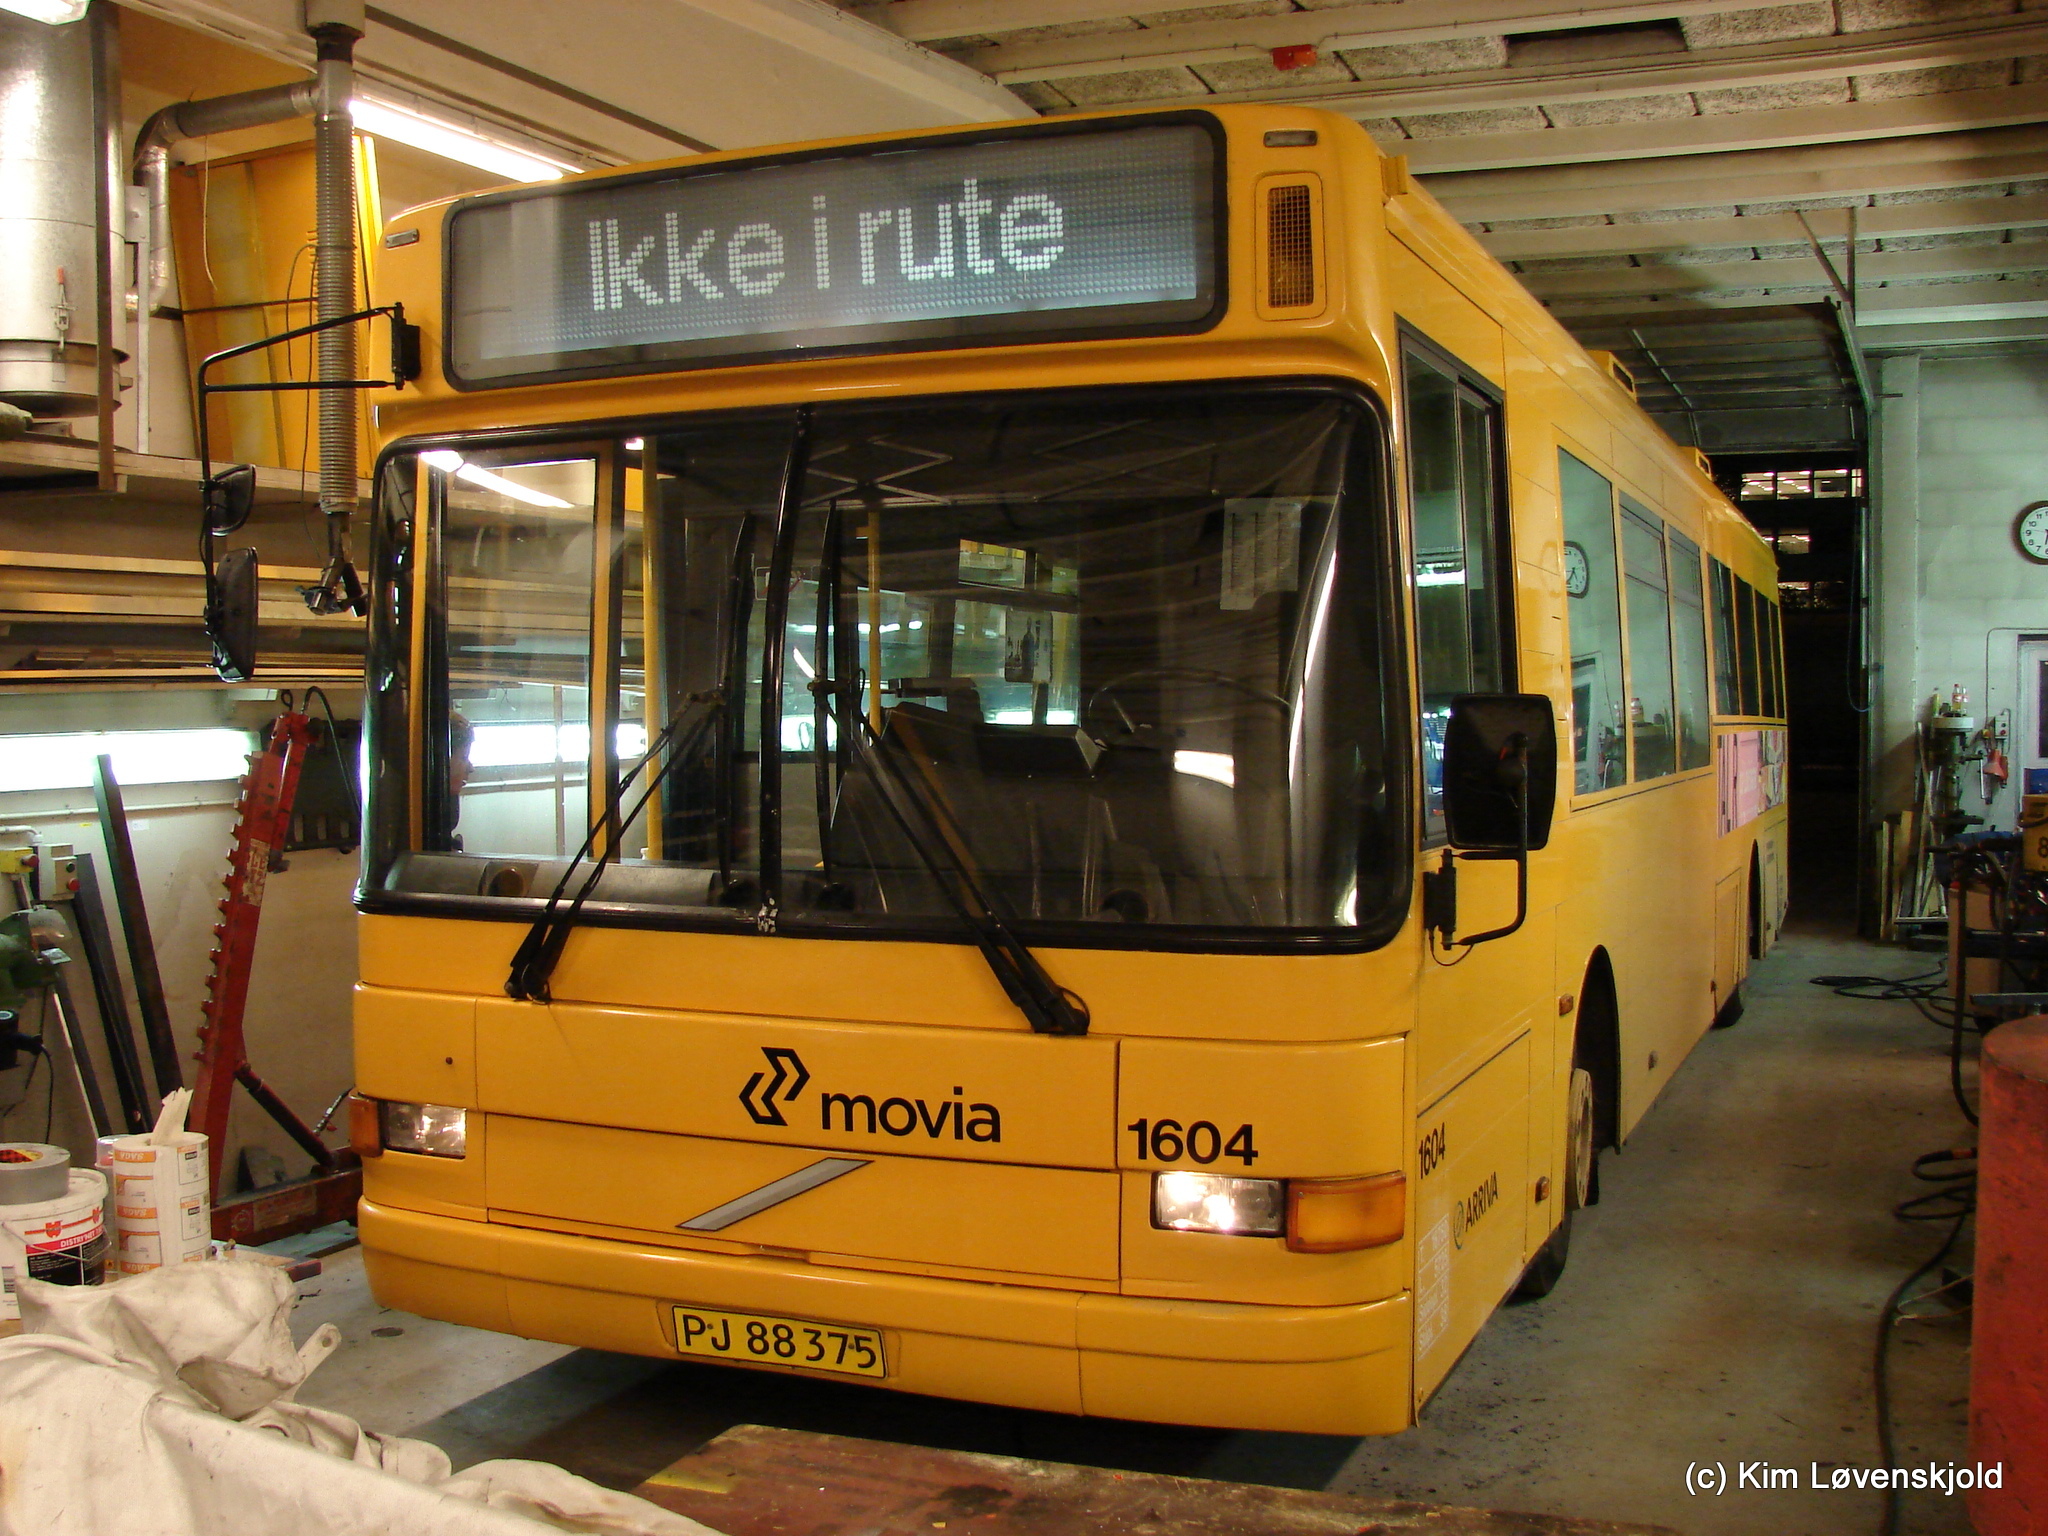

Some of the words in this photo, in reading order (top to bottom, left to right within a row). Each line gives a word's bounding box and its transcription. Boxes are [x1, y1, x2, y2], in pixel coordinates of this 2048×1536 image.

[589, 211, 786, 311] Ikke
[812, 195, 831, 289] i
[858, 178, 1065, 286] rute
[821, 1086, 1001, 1144] movia
[1127, 1117, 1259, 1167] 1604
[1418, 1122, 1446, 1180] 1604
[1465, 1171, 1498, 1233] ARRIVA
[682, 1314, 731, 1351] PJ
